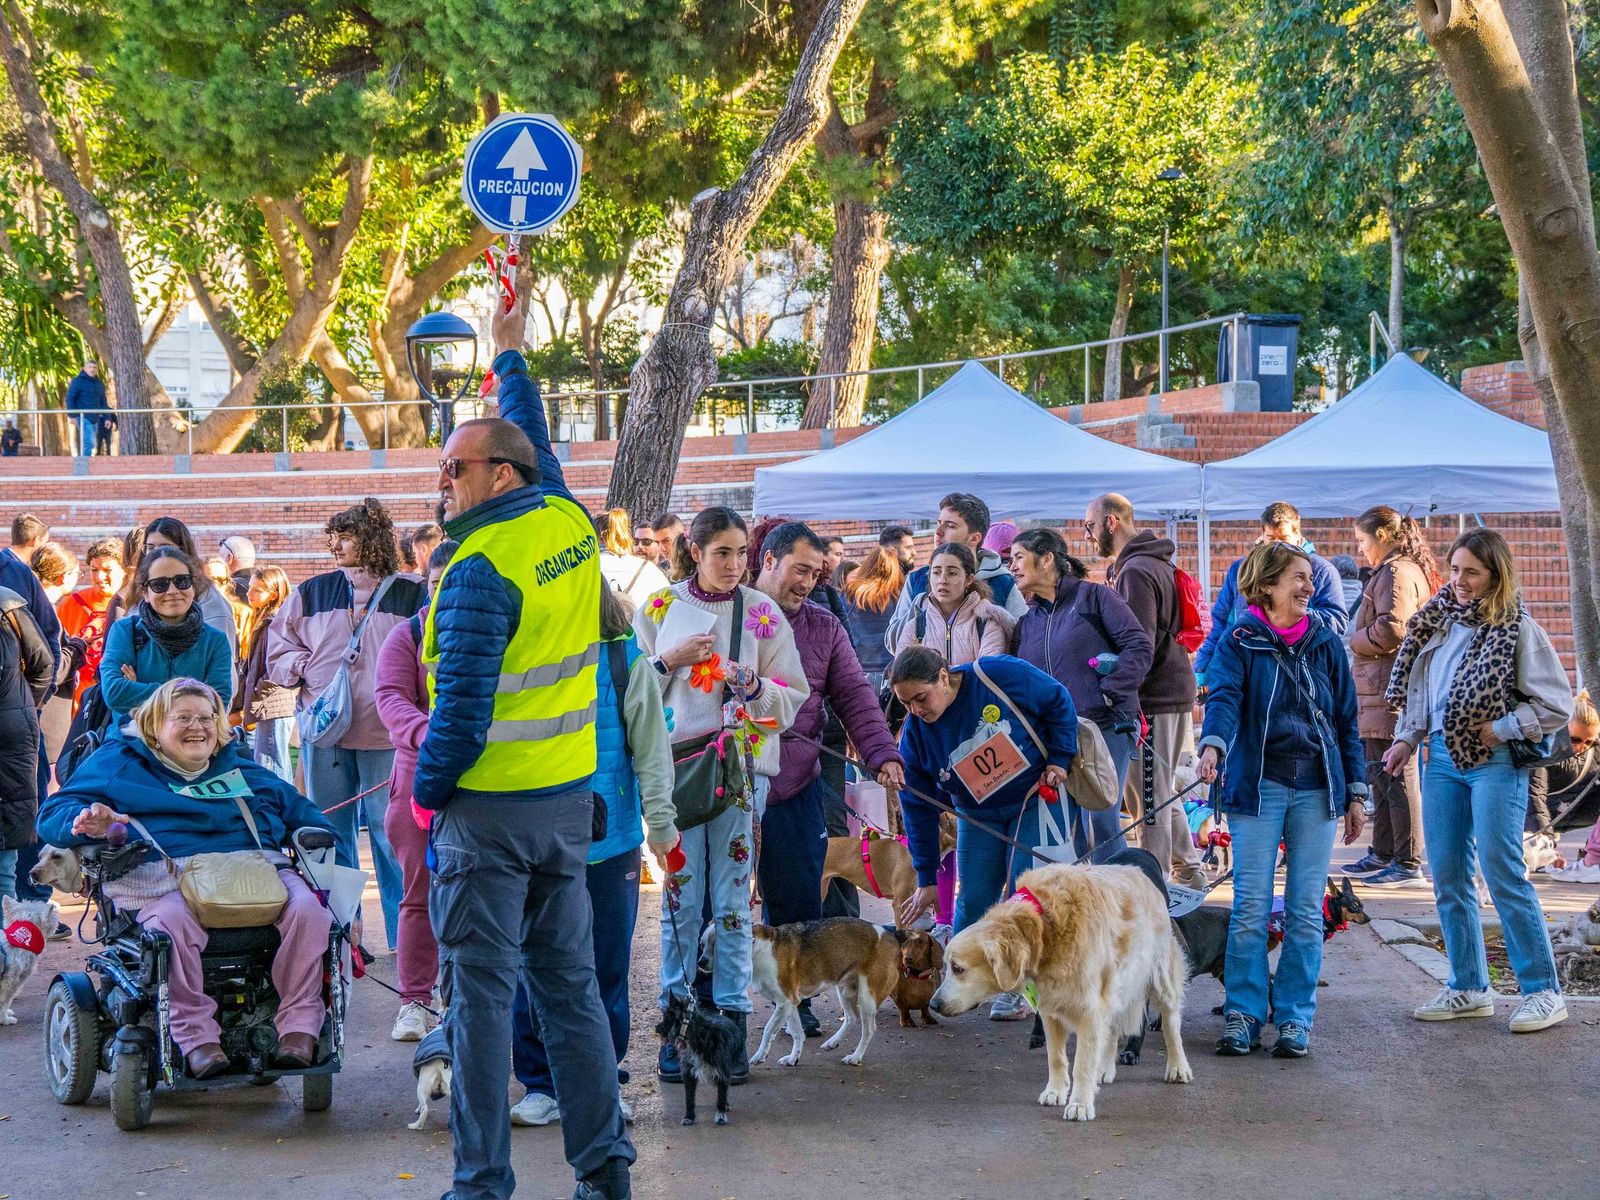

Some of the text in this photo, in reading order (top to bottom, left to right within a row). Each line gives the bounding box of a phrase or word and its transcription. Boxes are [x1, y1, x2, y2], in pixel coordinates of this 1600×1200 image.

[478, 179, 564, 196] PRECAUCION
[972, 746, 1004, 776] 02
[188, 779, 232, 796] 10
